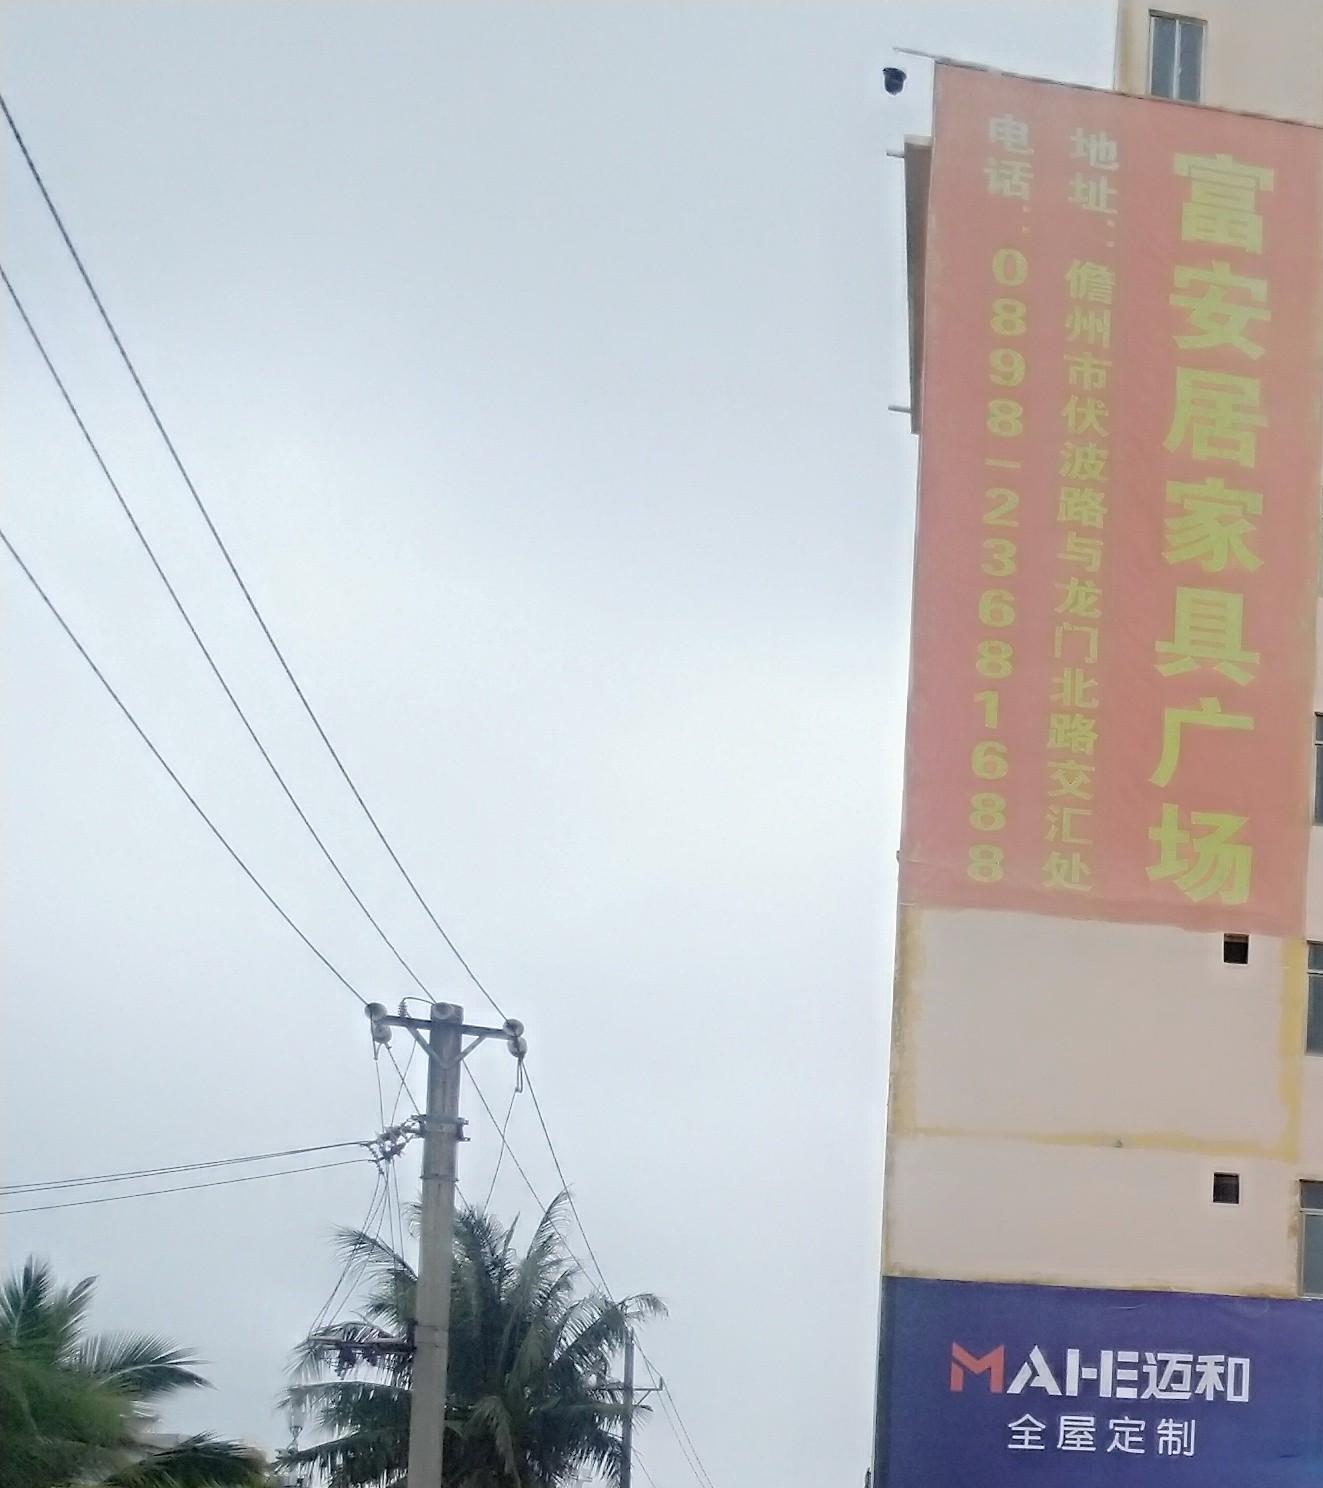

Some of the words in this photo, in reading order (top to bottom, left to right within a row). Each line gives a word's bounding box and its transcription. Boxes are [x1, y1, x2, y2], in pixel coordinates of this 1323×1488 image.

[1148, 151, 1275, 905] 富安居家具广场
[1007, 1414, 1197, 1456] 全屋定制
